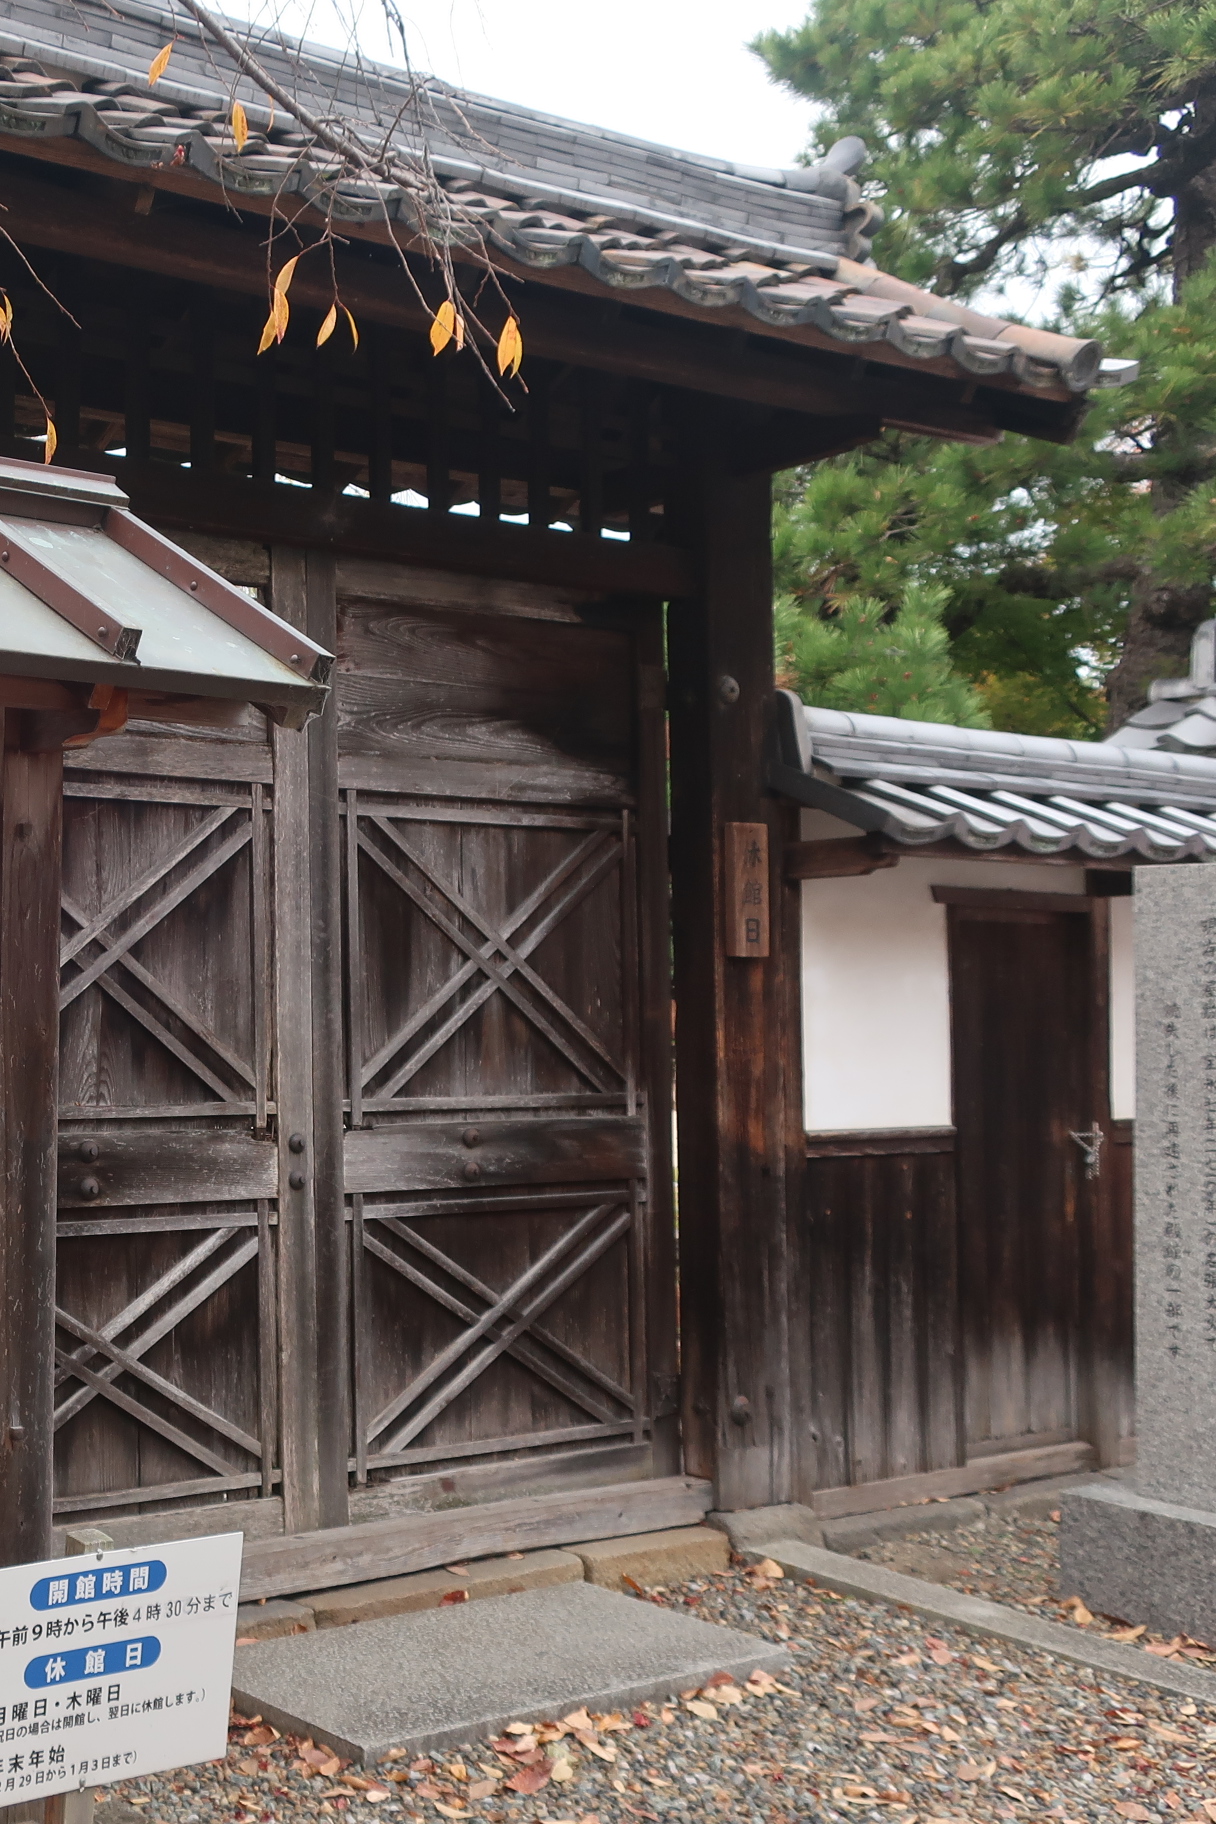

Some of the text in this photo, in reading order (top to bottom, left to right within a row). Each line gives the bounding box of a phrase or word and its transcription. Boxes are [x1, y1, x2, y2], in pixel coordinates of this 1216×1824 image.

[48, 1565, 150, 1606] 開館時間
[45, 1641, 144, 1683] 休館日
